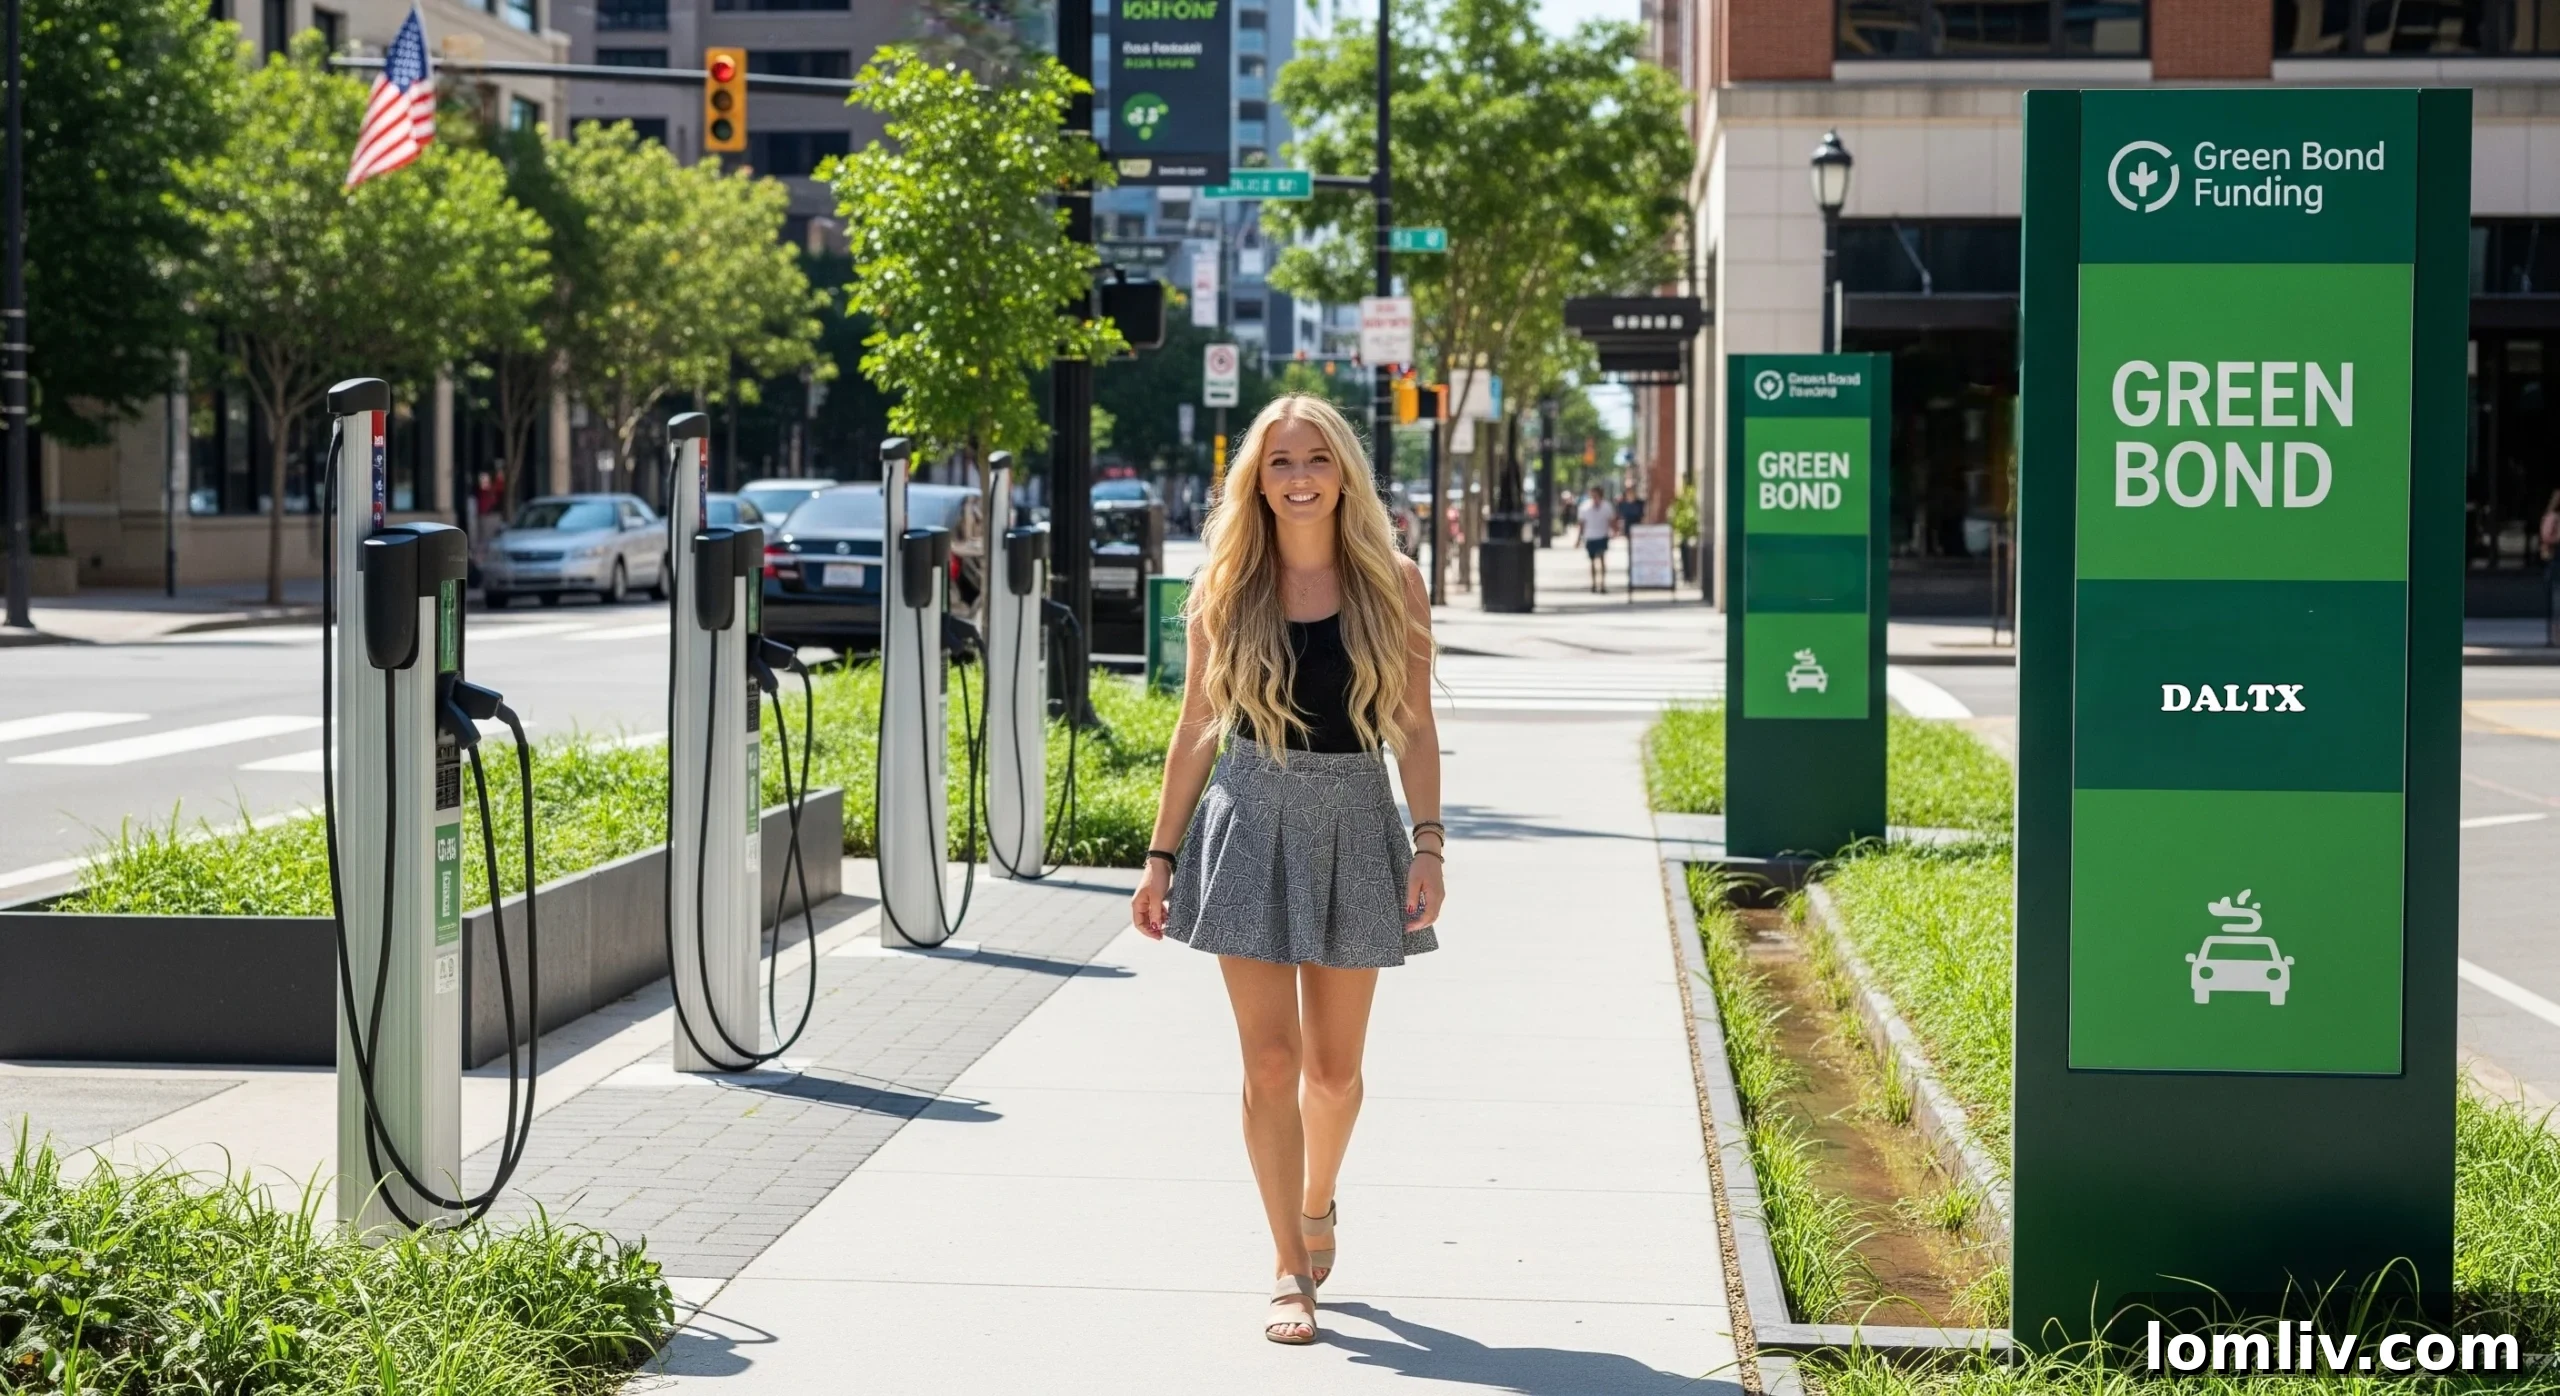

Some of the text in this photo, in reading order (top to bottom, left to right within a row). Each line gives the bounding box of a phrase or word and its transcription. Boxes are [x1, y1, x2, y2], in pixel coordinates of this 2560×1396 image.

[2194, 141, 2385, 171] Green Bond
[2194, 175, 2323, 214] Funding
[2112, 360, 2354, 427] GREEN
[1758, 451, 1850, 479] GREEN
[2115, 440, 2333, 508] BOND
[1759, 481, 1842, 510] BOND
